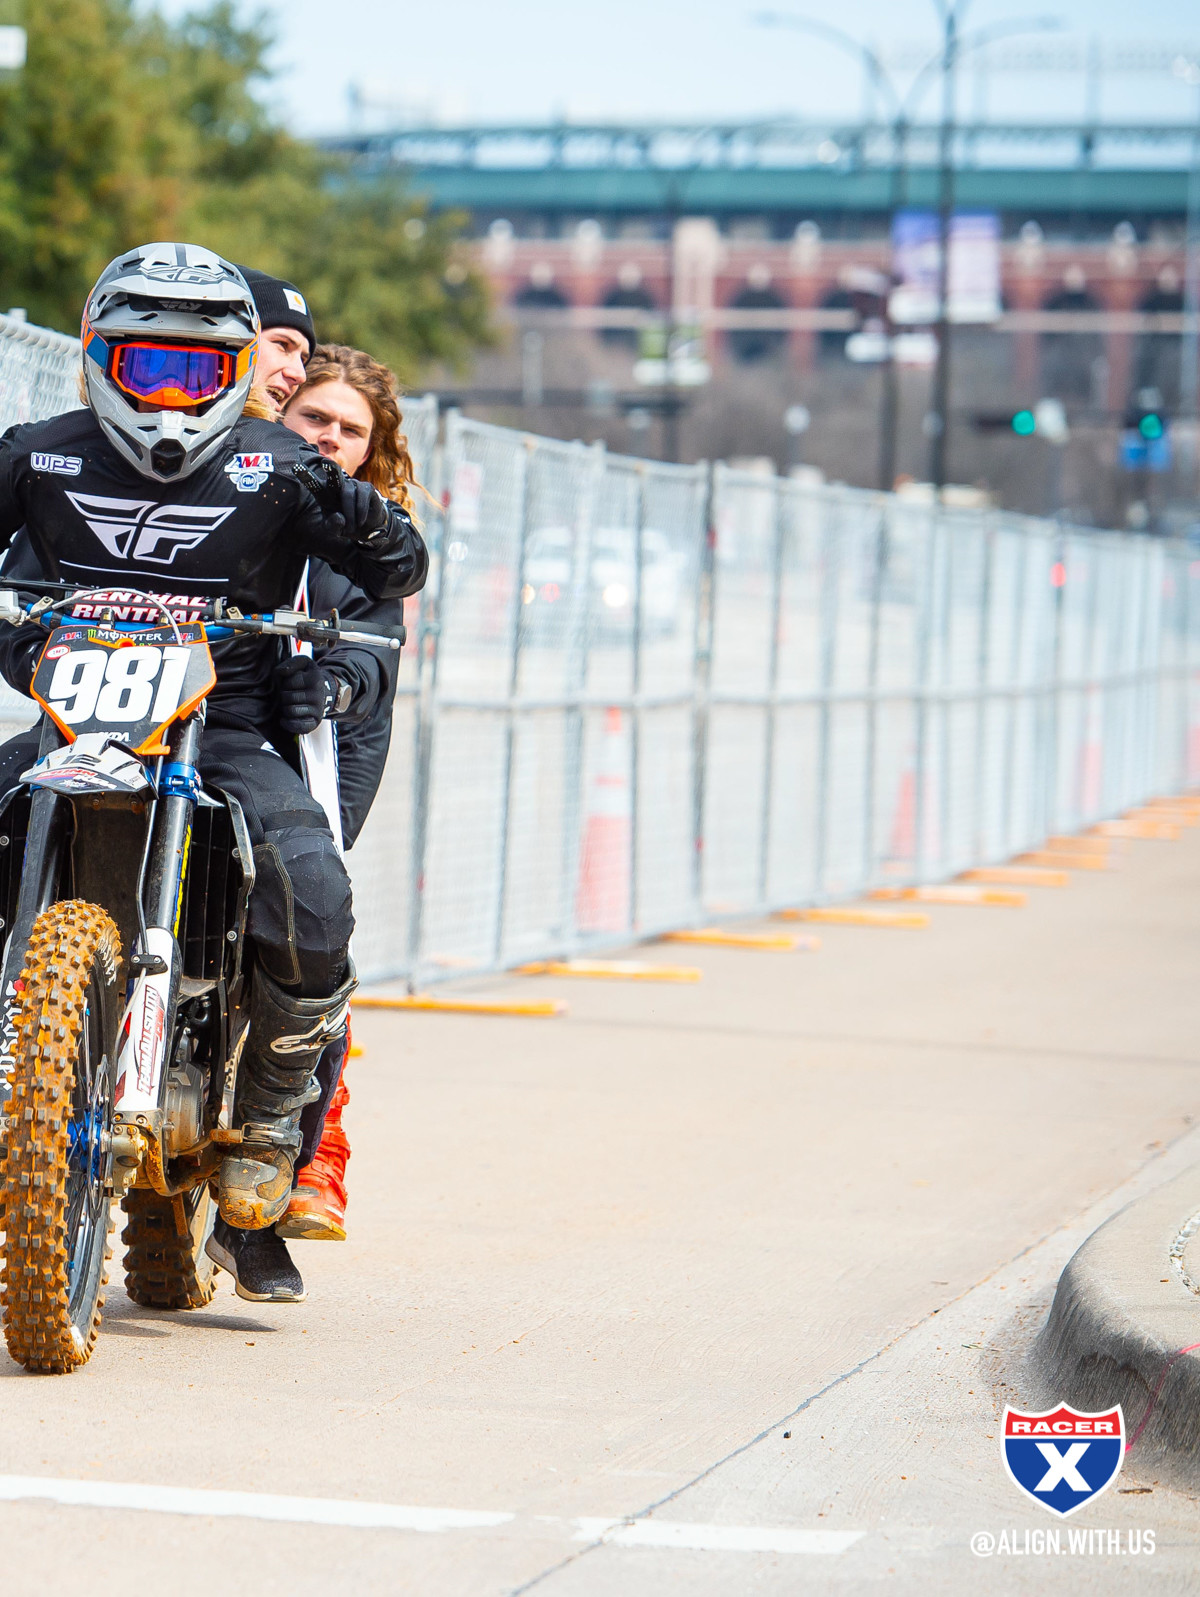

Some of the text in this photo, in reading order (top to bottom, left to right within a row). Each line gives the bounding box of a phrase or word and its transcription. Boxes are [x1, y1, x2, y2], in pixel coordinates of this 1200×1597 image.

[31, 452, 82, 475] WPS
[227, 454, 272, 470] AMA
[241, 476, 255, 486] FIM
[47, 646, 191, 725] 981
